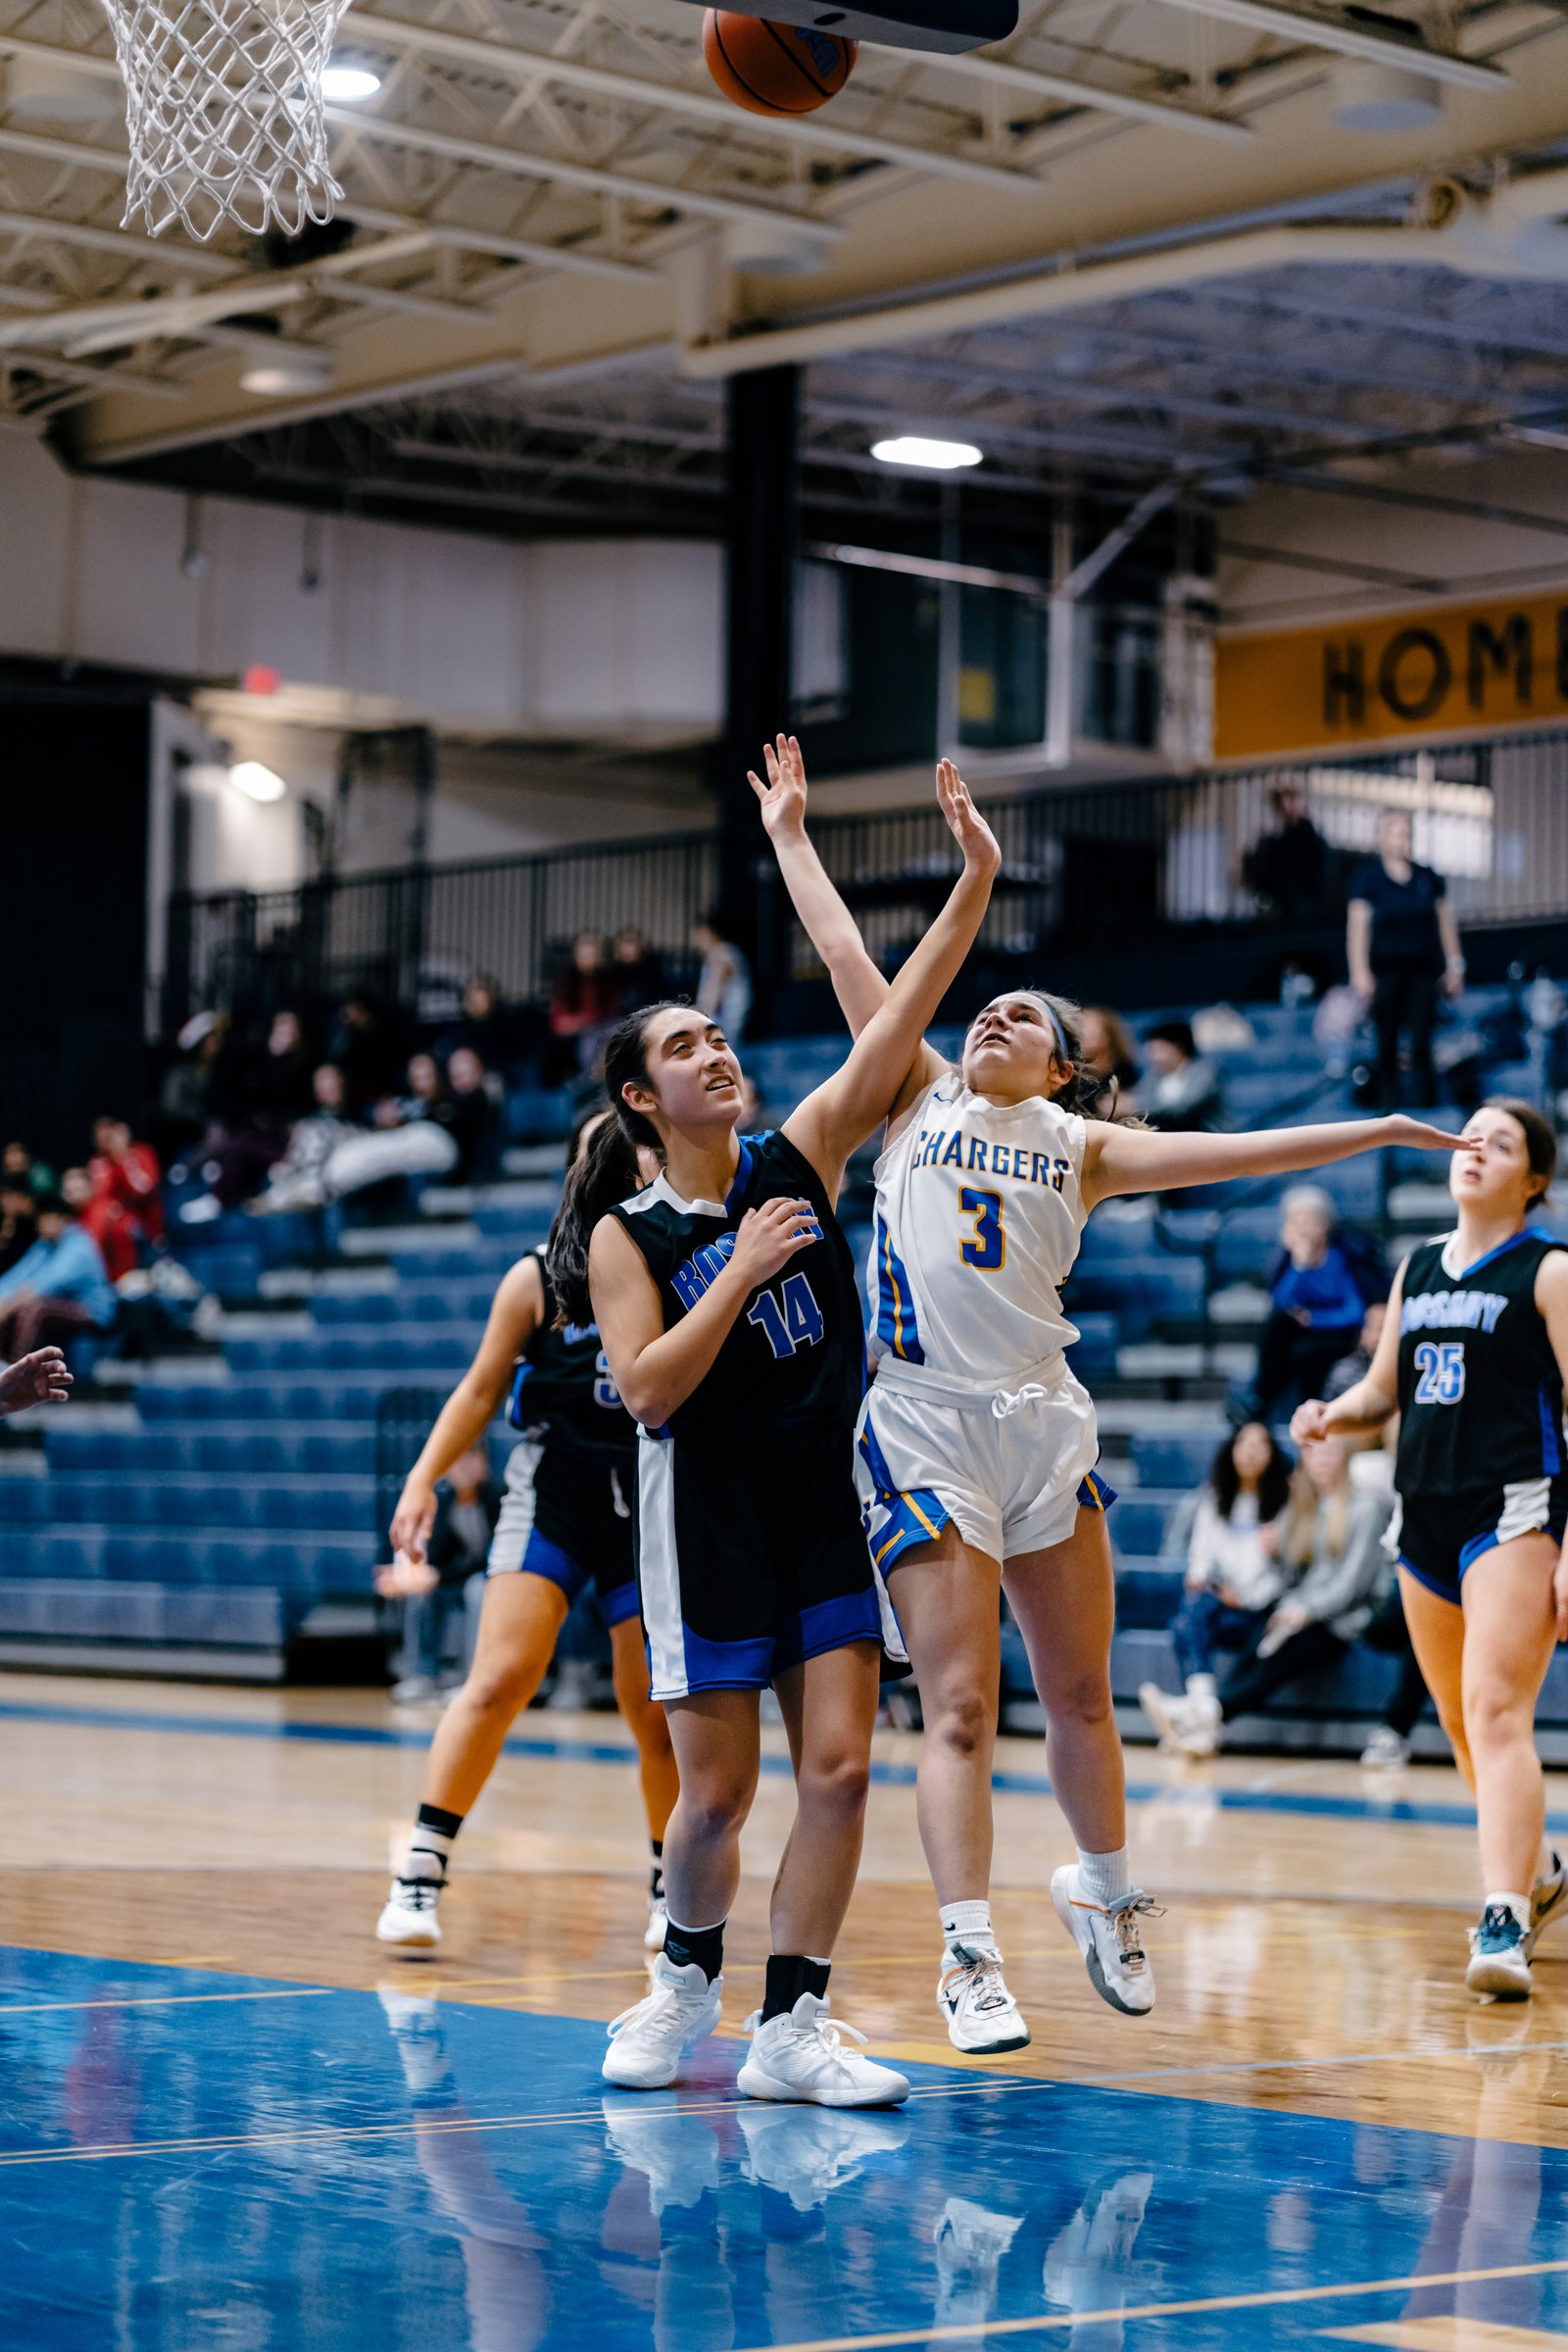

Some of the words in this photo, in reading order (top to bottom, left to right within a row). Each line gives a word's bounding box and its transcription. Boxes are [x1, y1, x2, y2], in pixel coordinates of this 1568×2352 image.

[1323, 604, 1568, 730] HOM
[912, 1130, 1071, 1194] CHARGERS
[958, 1185, 1006, 1272] 3
[747, 1272, 824, 1359] 14
[1414, 1342, 1465, 1404] 25
